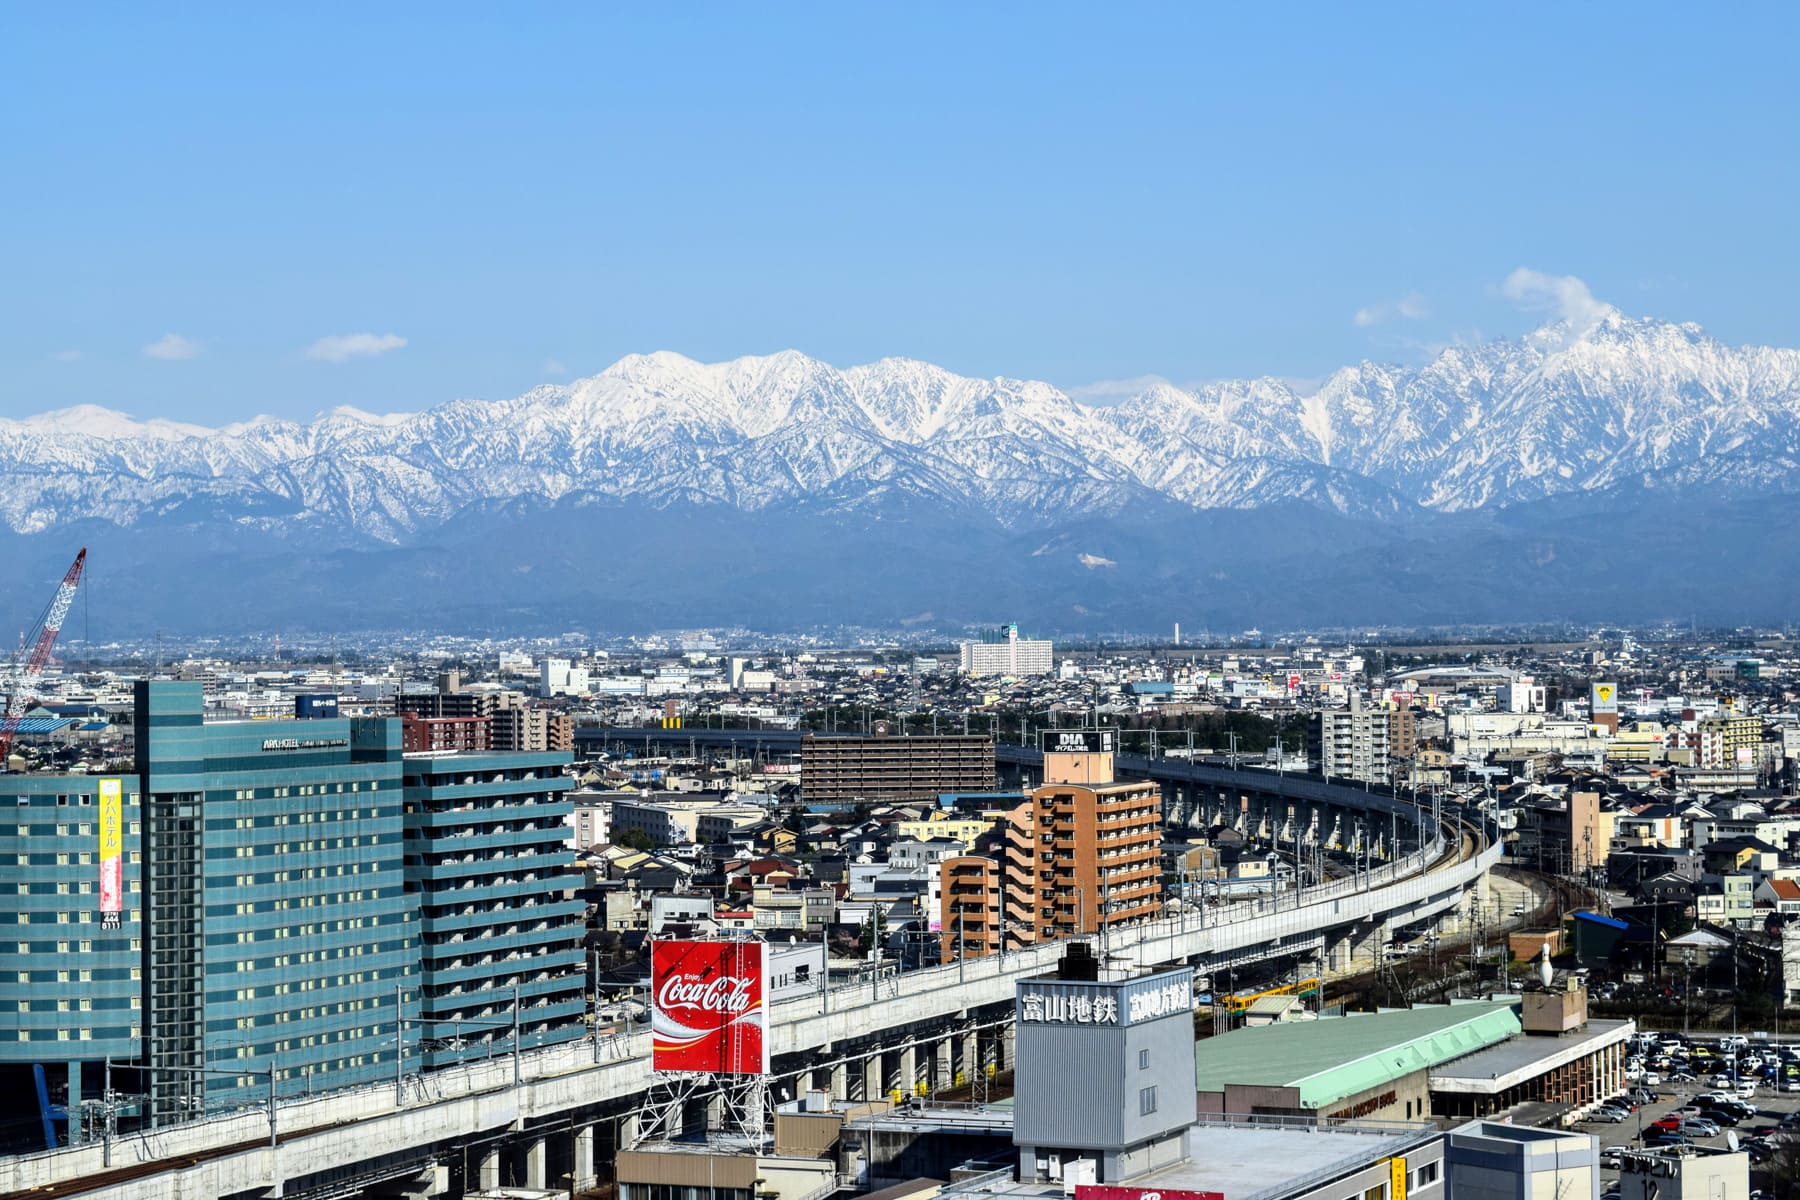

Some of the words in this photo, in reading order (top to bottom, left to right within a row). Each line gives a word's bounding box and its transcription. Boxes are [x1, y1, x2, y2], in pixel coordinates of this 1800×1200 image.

[280, 738, 300, 748] HOTEL
[1059, 733, 1085, 744] DIA
[658, 974, 756, 1011] Coca-Cola
[1129, 981, 1190, 1023] 富山地方鉄道
[1022, 993, 1118, 1024] 富山地鉄
